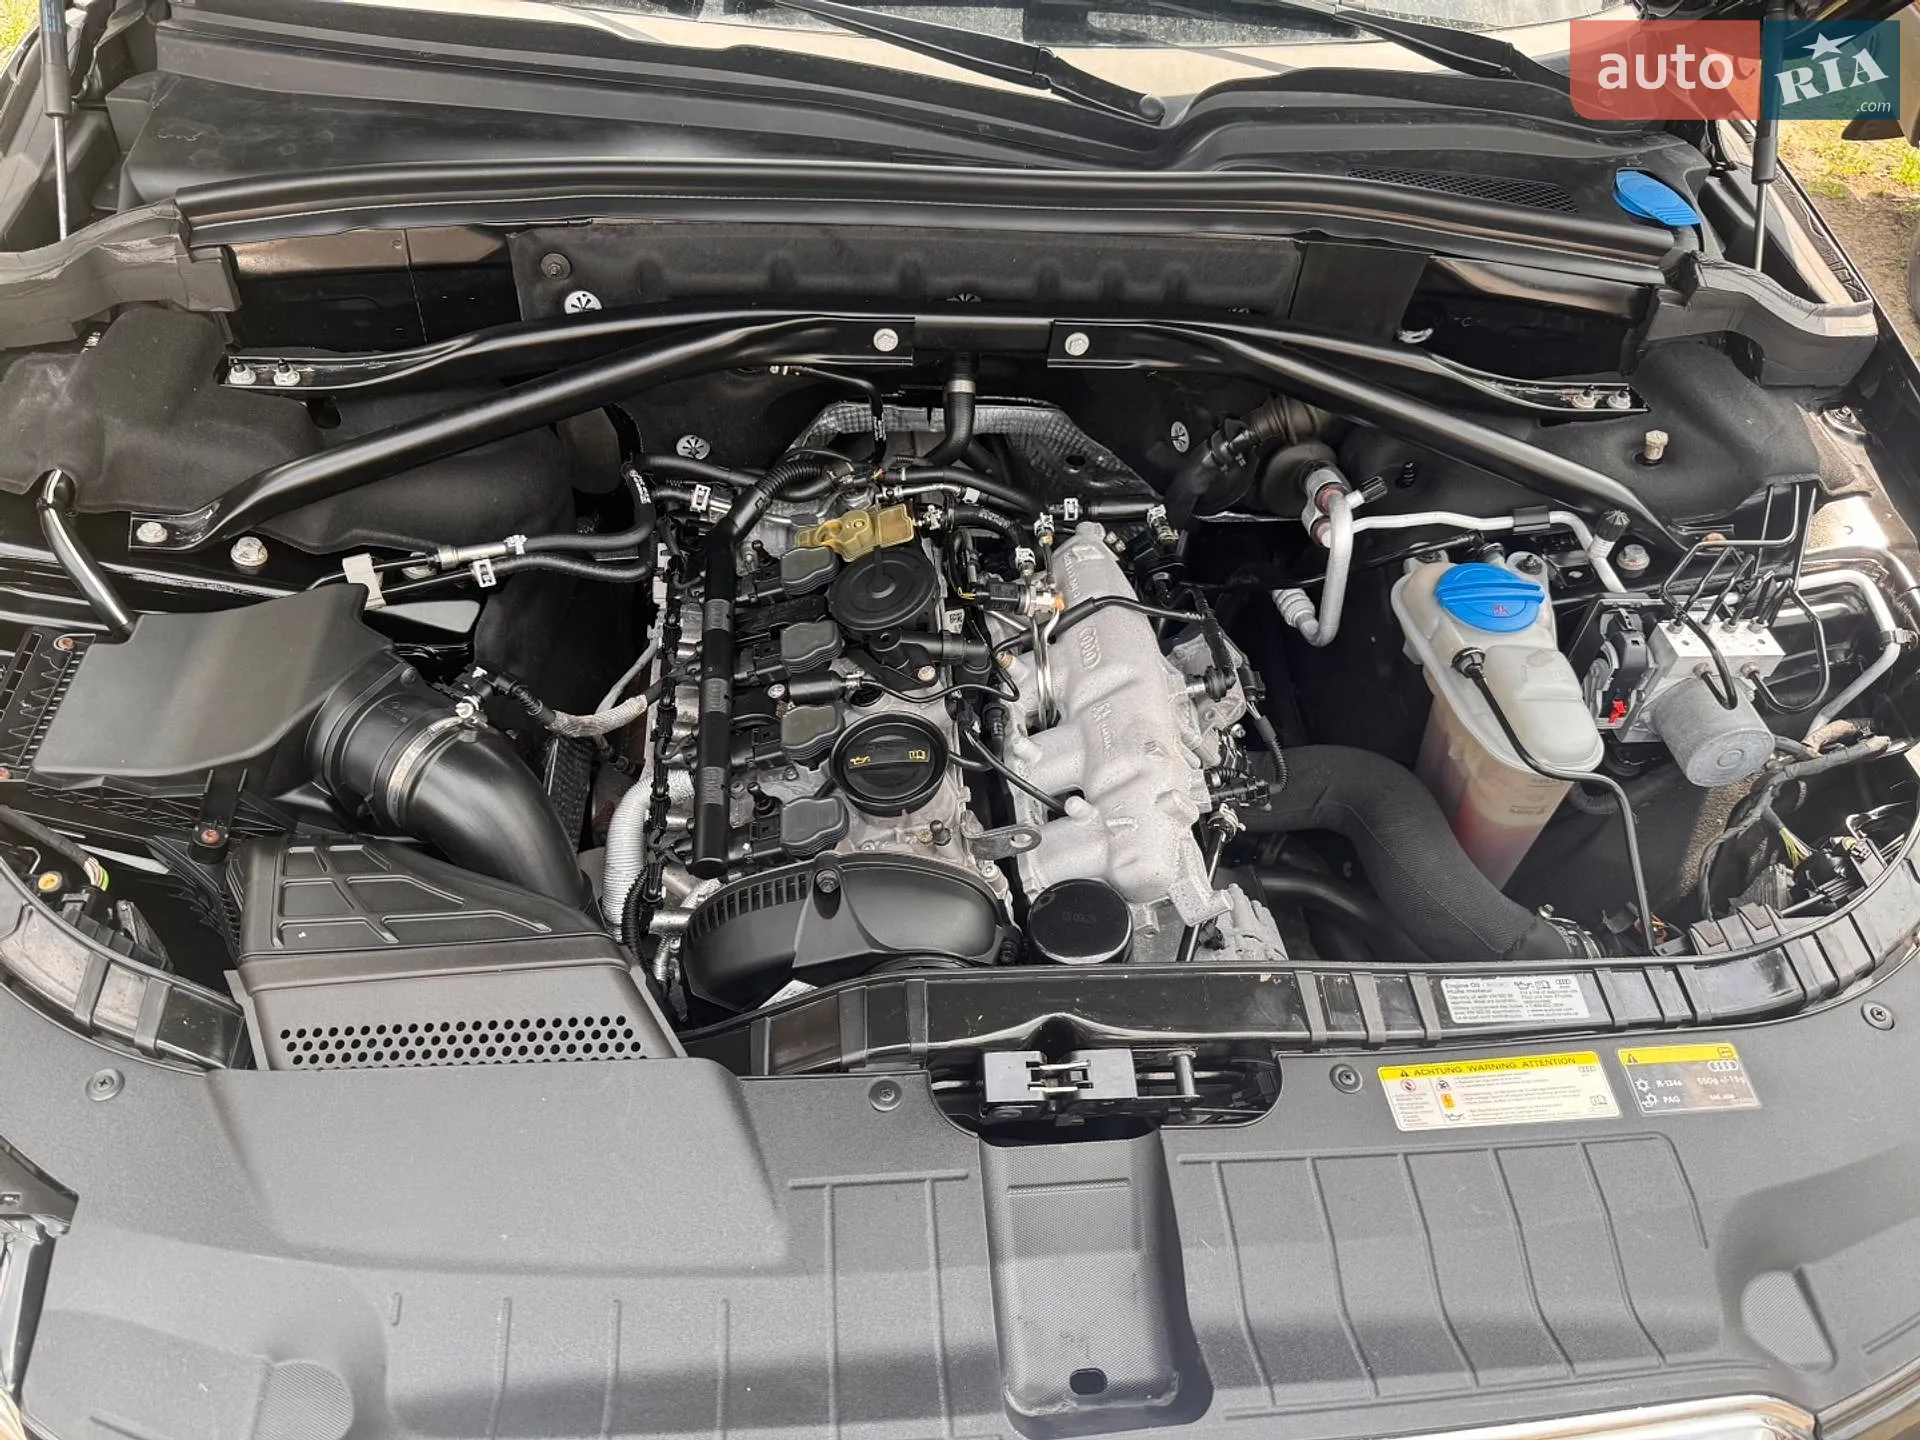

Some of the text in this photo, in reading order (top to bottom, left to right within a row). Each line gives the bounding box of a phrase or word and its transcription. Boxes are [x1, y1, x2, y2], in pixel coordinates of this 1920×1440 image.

[1414, 1057, 1577, 1076] ACHTUNG WARNING ATTENTION
